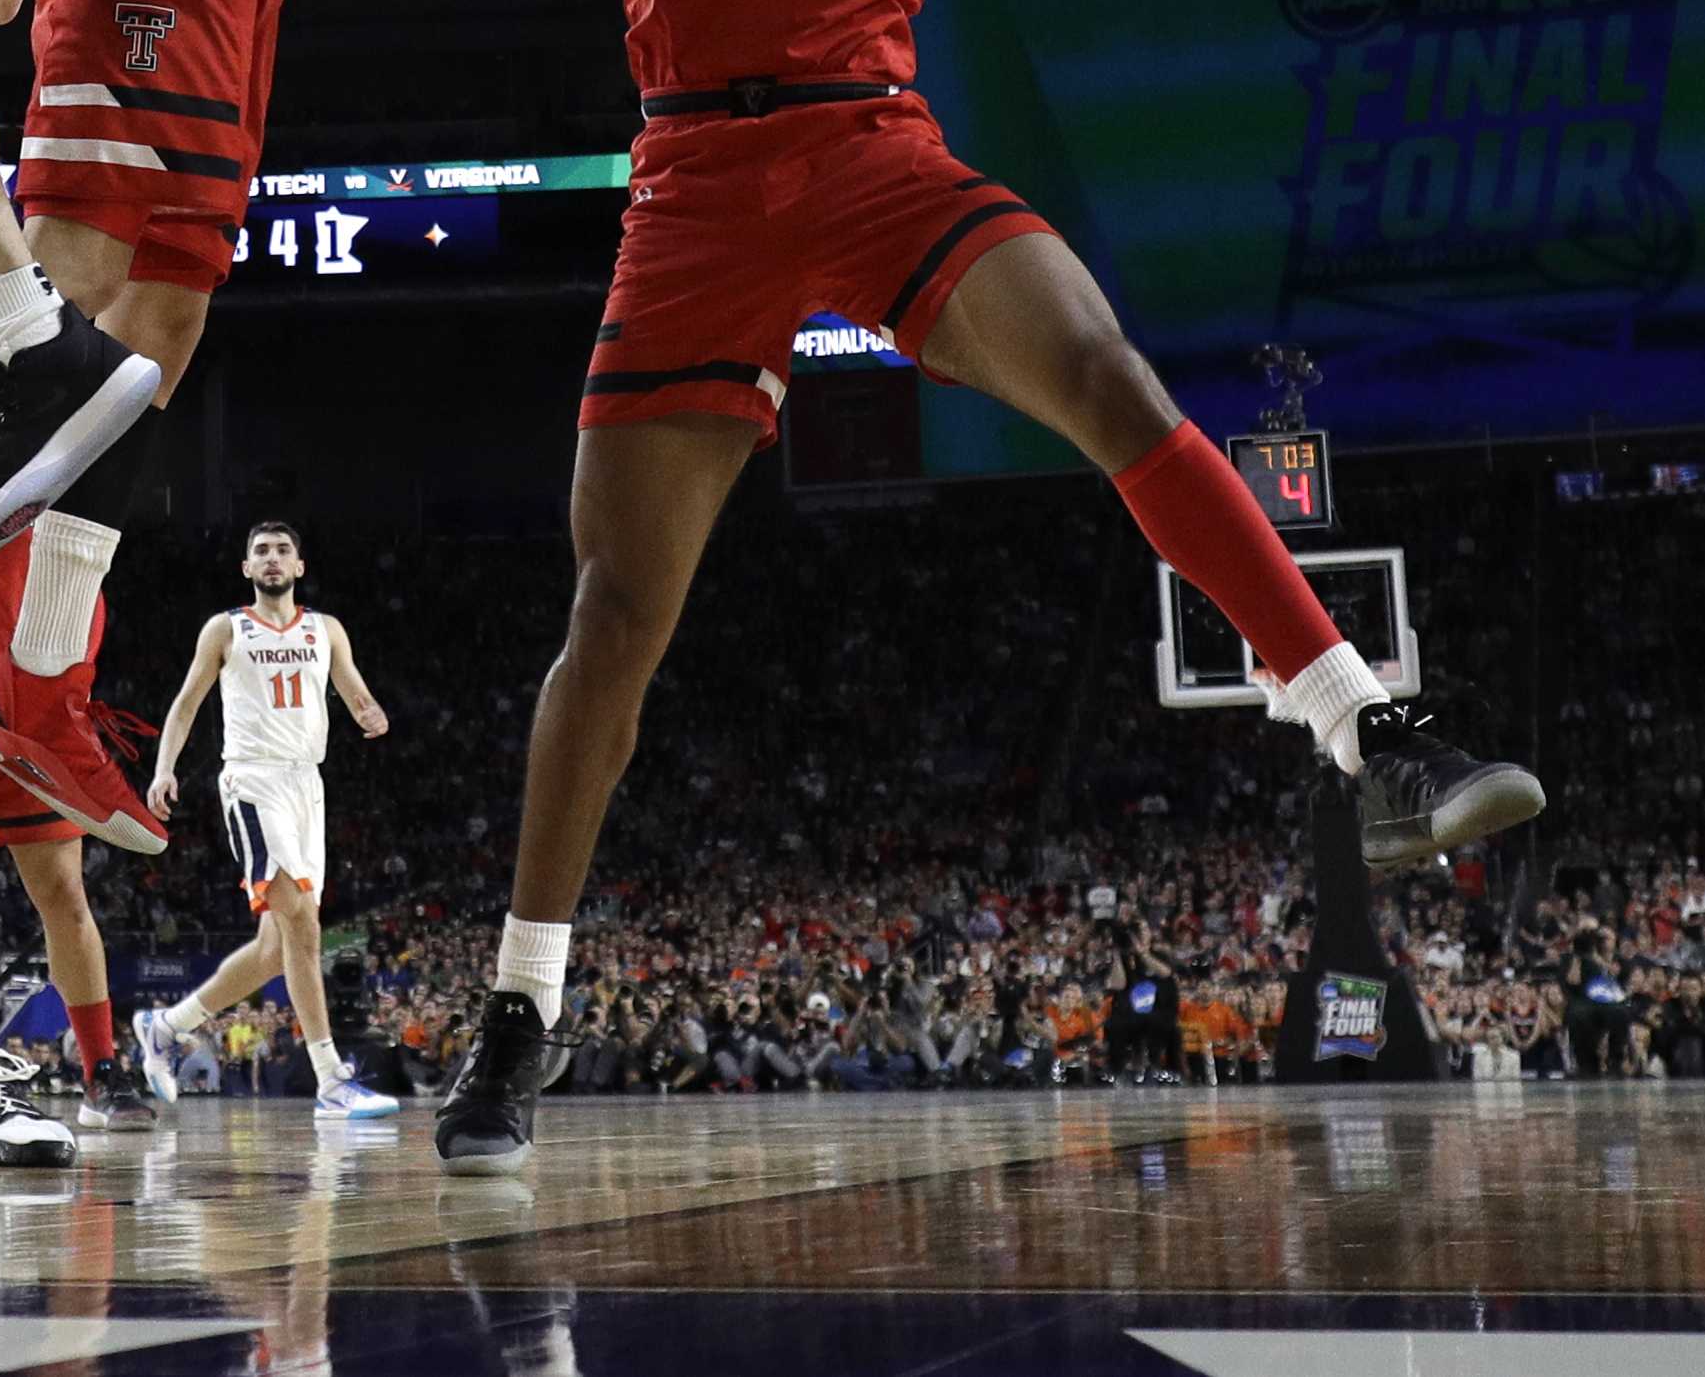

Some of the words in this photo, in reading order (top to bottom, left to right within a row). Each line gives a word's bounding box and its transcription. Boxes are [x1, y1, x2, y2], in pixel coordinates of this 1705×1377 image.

[1324, 14, 1649, 137] FINAL
[262, 174, 325, 196] TECH
[424, 164, 541, 189] VIRGINIA
[1308, 122, 1637, 248] FOUR
[269, 219, 298, 266] 4
[1279, 472, 1313, 516] 4
[247, 649, 319, 664] VIRGINIA
[268, 670, 305, 709] 11
[1323, 1017, 1376, 1037] FOUR
[1326, 999, 1377, 1019] FINAL
